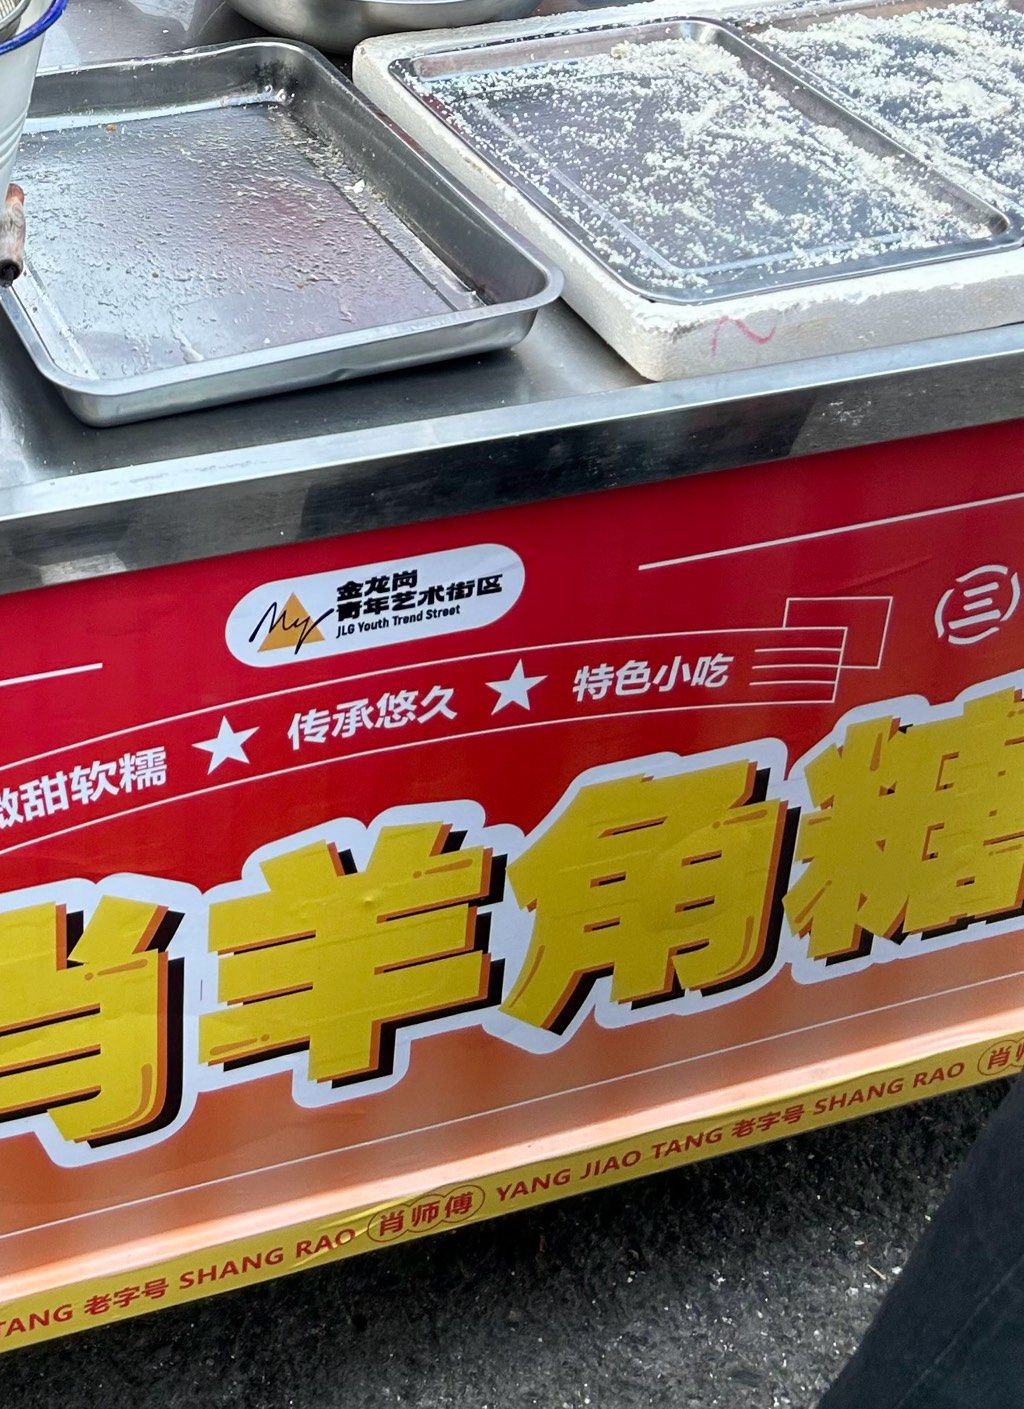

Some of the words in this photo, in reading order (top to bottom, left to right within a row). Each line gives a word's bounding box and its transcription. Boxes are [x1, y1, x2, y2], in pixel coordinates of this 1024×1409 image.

[336, 569, 418, 602] 金龙岗
[336, 573, 504, 622] 青年艺术街区
[335, 625, 356, 639] JLG
[358, 616, 390, 634] Youth
[392, 610, 424, 627] Trend
[425, 604, 461, 621] Street
[571, 652, 735, 703] 特色小吃
[287, 684, 459, 751] 传承悠久
[83, 1277, 170, 1316] 老字号
[178, 1246, 285, 1290] SHANG
[295, 1227, 357, 1259] RAO
[378, 1191, 475, 1235] 肖师傅
[496, 1167, 573, 1203] YANG
[579, 1149, 642, 1180] JIAO
[651, 1126, 724, 1160] TANG
[730, 1103, 805, 1139] 老字号
[812, 1077, 904, 1116] SHANG
[912, 1061, 966, 1090] RAO
